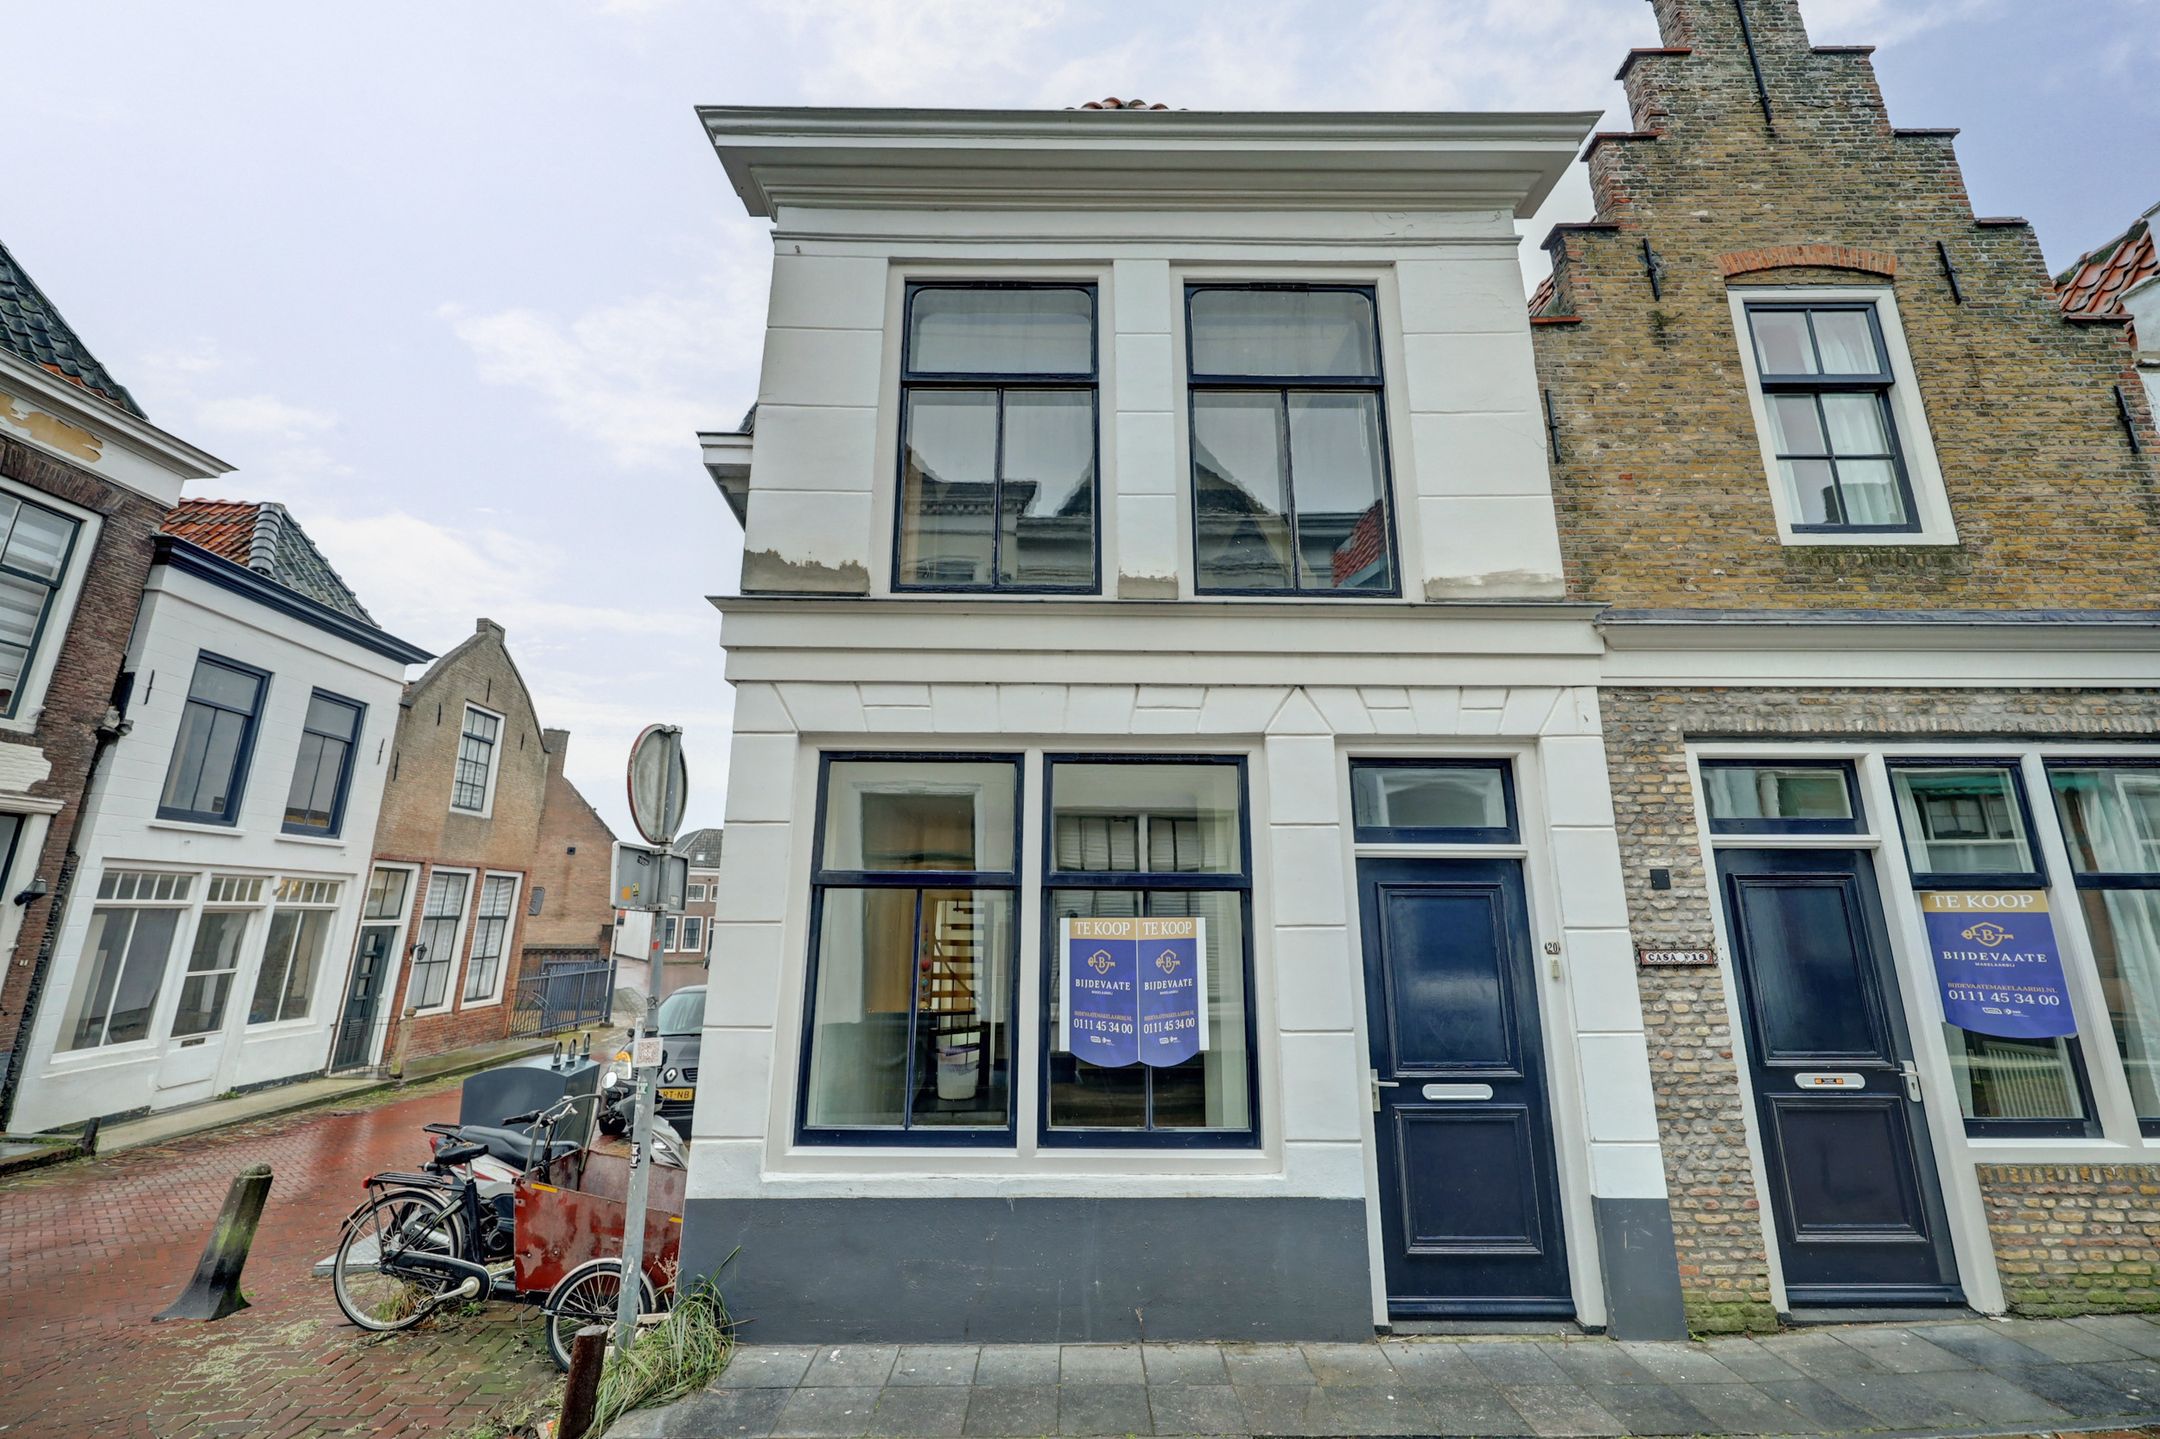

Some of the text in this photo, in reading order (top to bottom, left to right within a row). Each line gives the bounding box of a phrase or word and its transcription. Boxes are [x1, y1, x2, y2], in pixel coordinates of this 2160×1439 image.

[1930, 895, 2033, 908] TE KOOP
[1075, 921, 1130, 936] TE KOOP
[1143, 921, 1192, 935] TE KOOP
[1547, 942, 1558, 953] 20
[1648, 953, 1705, 961] CASA 18
[1943, 951, 2048, 963] BIJDEVAATE
[1075, 978, 1131, 991] BIJDEVAATE
[1144, 978, 1193, 991] BIJDEVAATE
[1948, 990, 2060, 1006] 0111 45 34 00
[1073, 1018, 1133, 1034] 0111 45 34 00
[1143, 1017, 1195, 1034] 0111 45 34 00
